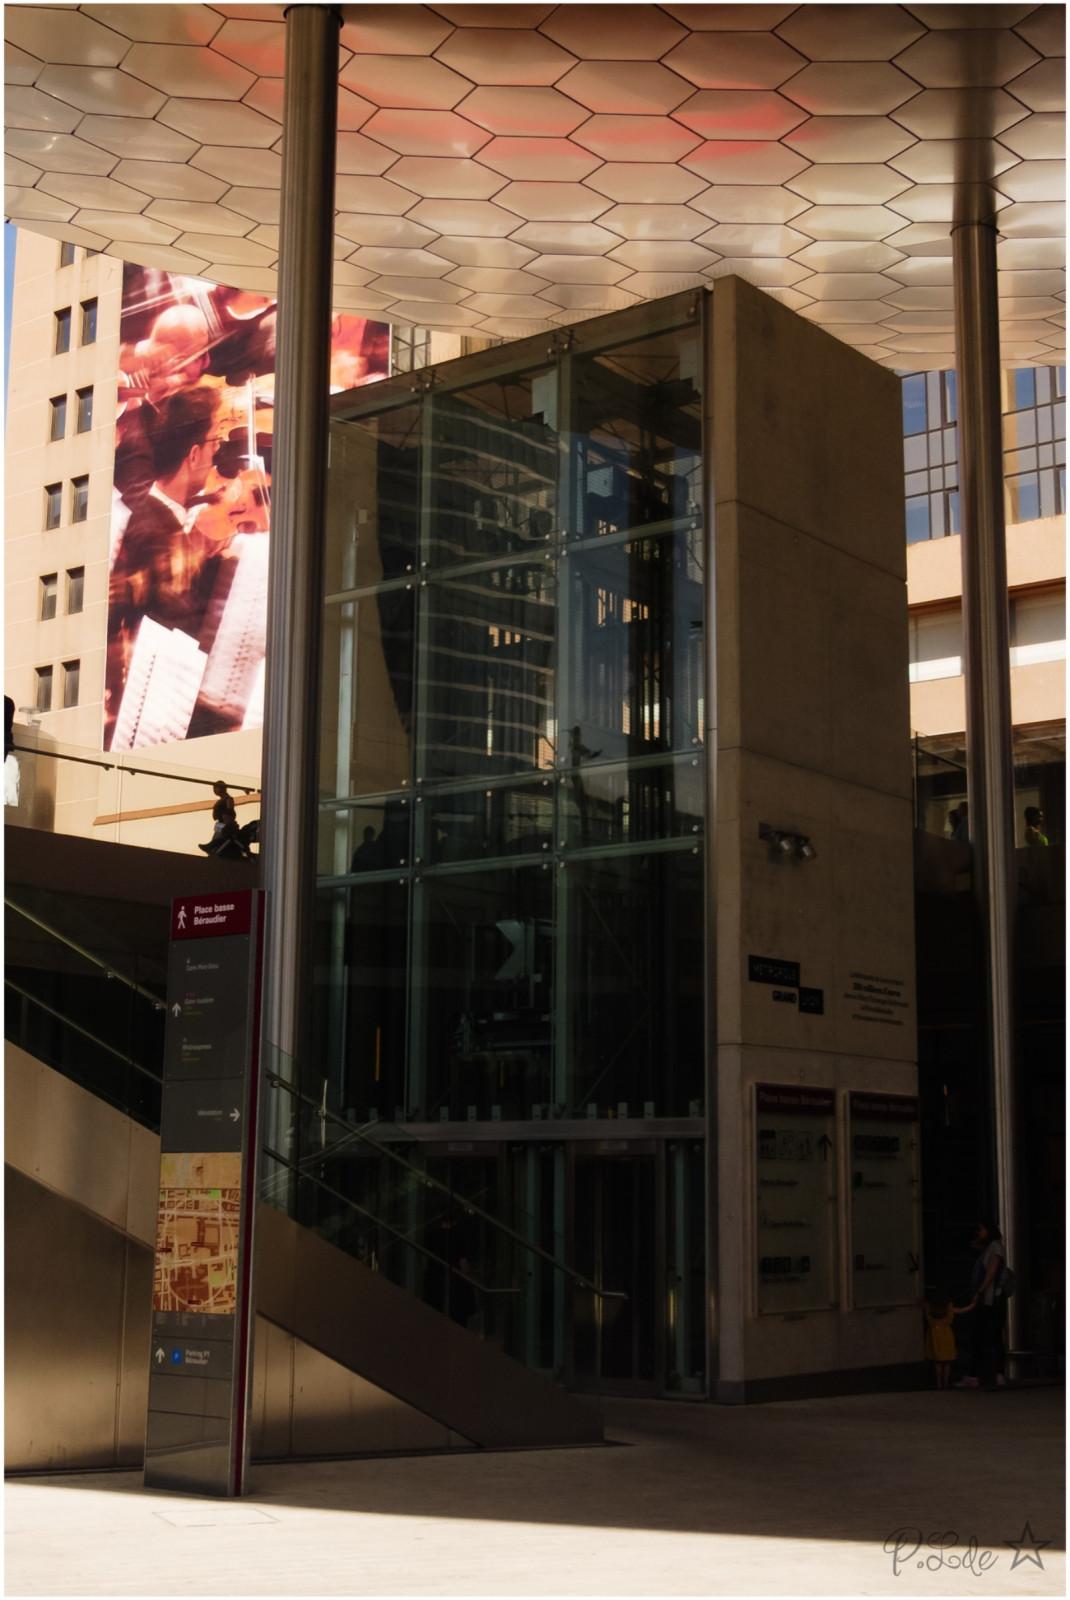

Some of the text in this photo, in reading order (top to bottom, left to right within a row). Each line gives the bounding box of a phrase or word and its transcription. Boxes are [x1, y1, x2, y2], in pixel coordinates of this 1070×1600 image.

[194, 904, 235, 914] Place basse
[193, 914, 227, 925] Béraudier
[772, 990, 797, 1003] GRAND
